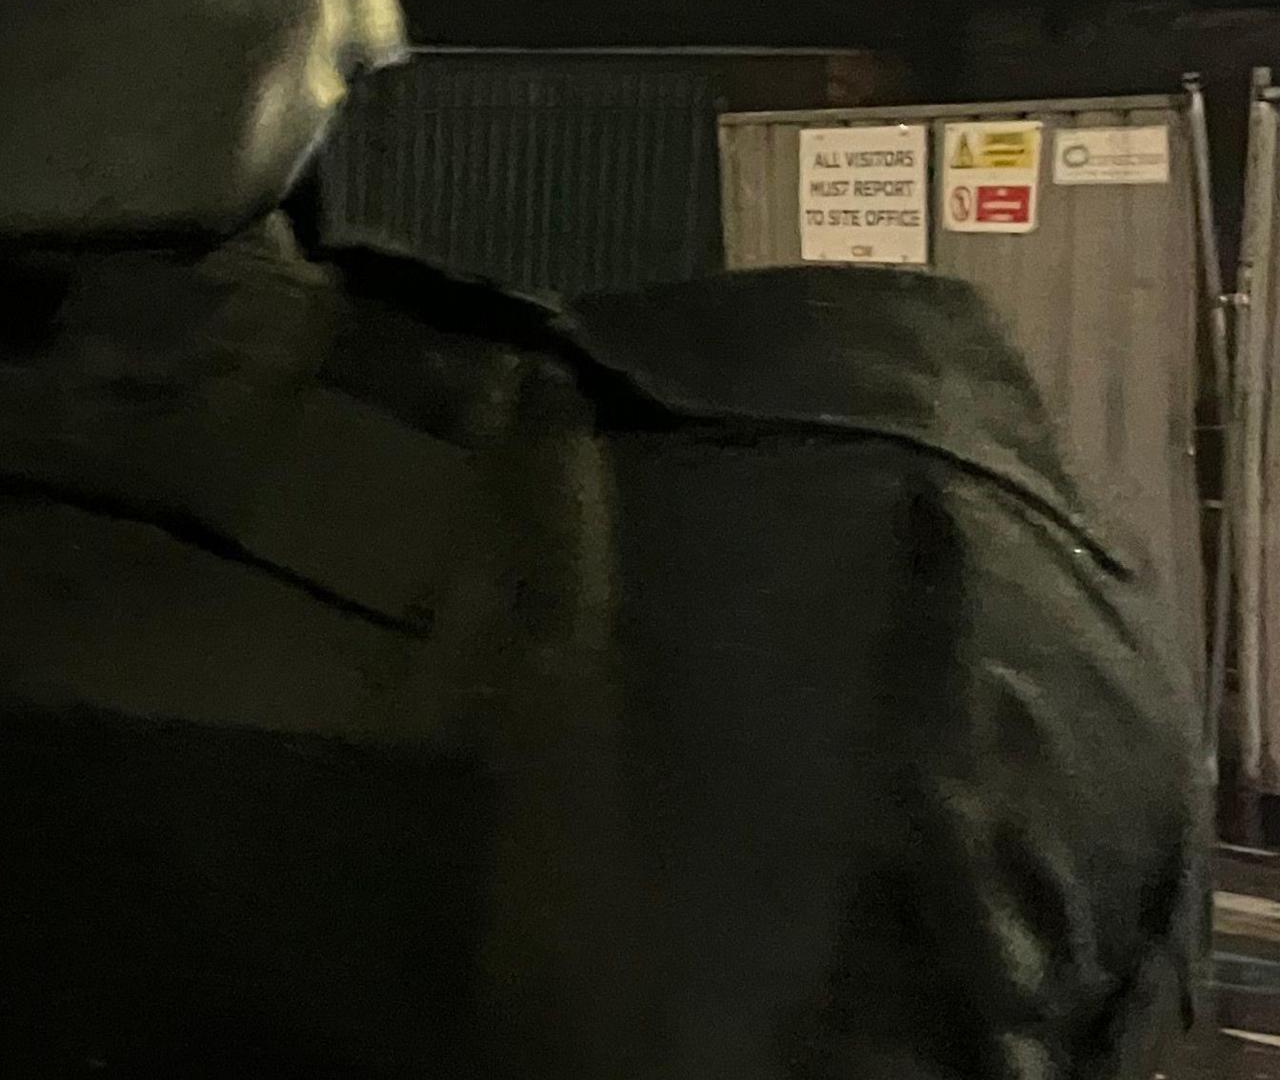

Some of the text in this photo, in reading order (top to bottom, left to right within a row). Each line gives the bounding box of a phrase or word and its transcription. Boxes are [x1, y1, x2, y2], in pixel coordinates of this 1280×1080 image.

[814, 150, 914, 169] ALL VISITORS
[810, 180, 915, 197] MUST REPORT
[805, 209, 921, 227] TO SITE OFFICE
